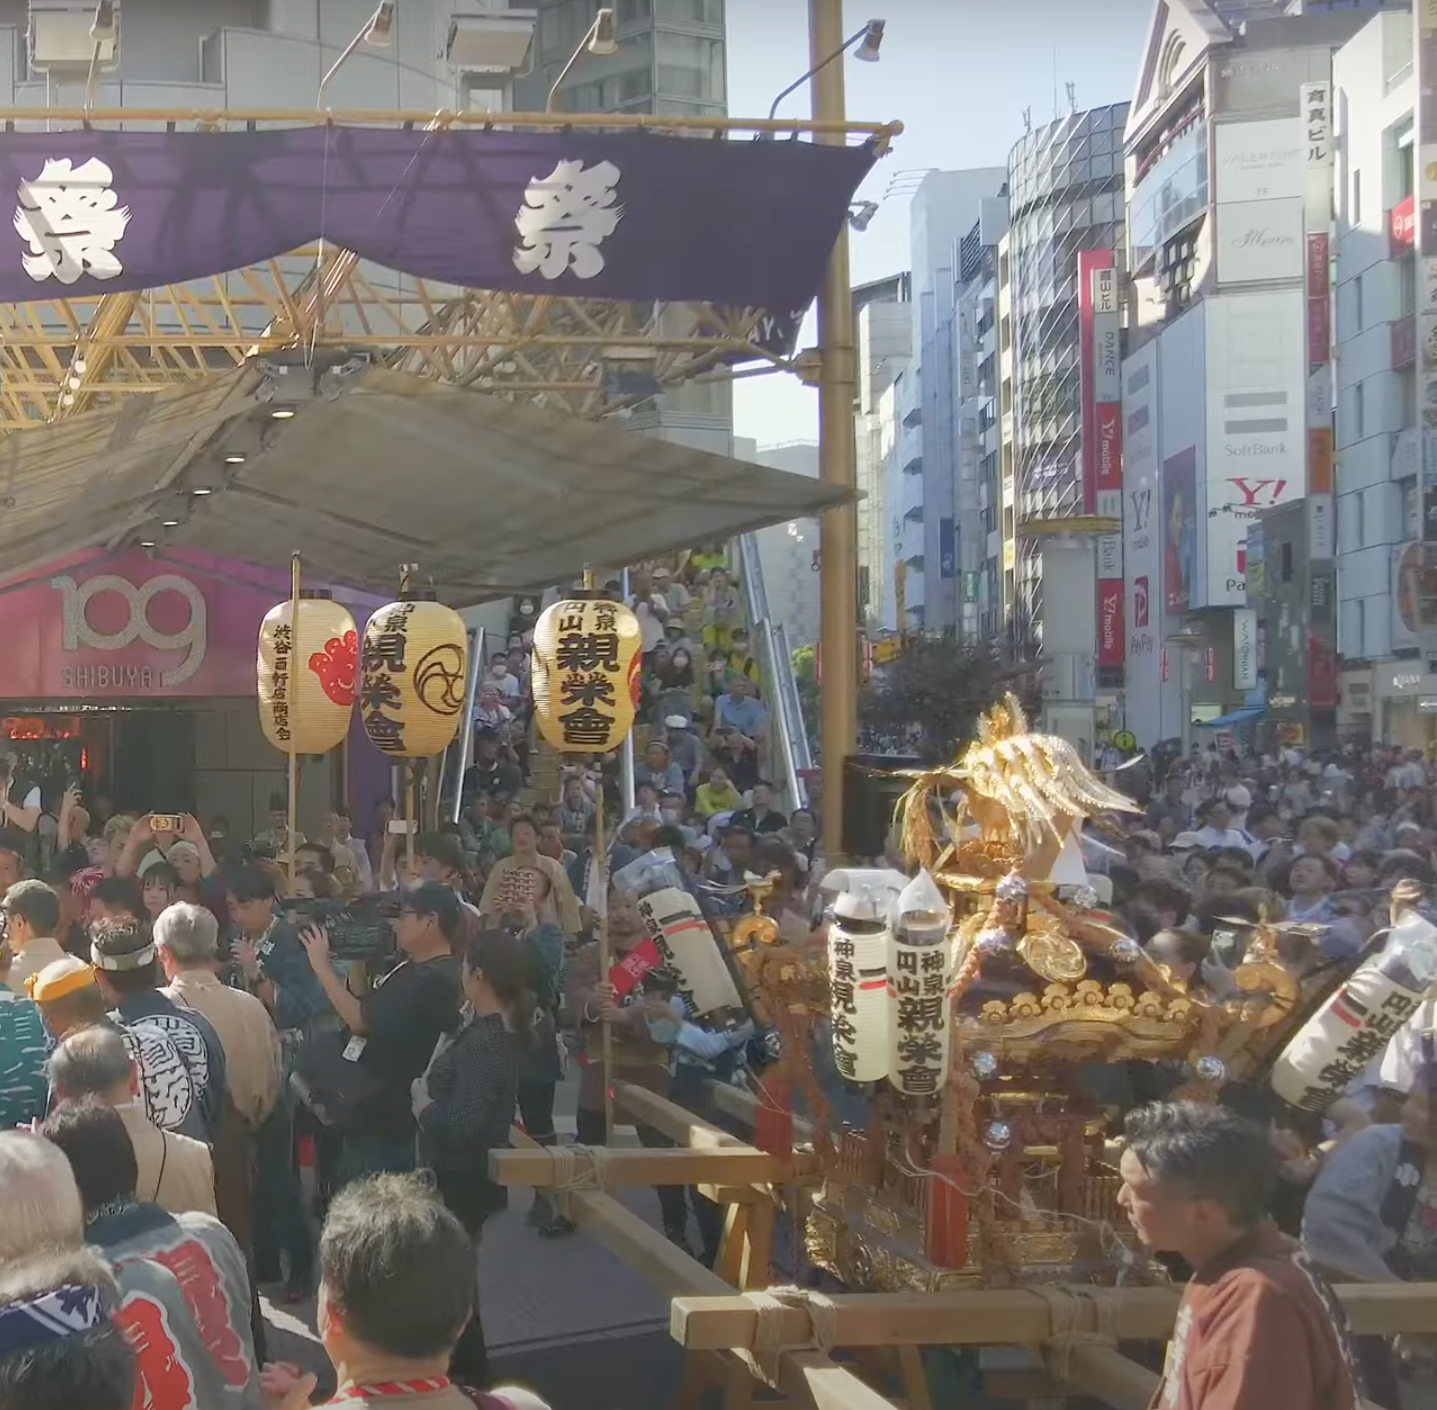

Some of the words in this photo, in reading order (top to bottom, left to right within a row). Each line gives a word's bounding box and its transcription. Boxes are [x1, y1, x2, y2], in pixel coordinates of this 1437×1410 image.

[13, 156, 133, 285] 祭
[512, 158, 625, 280] 祭
[1105, 331, 1115, 376] DANCE
[1224, 442, 1288, 458] SoftBank
[1225, 477, 1288, 506] Y!
[50, 574, 207, 686] 109
[62, 665, 152, 689] SHIBUYA
